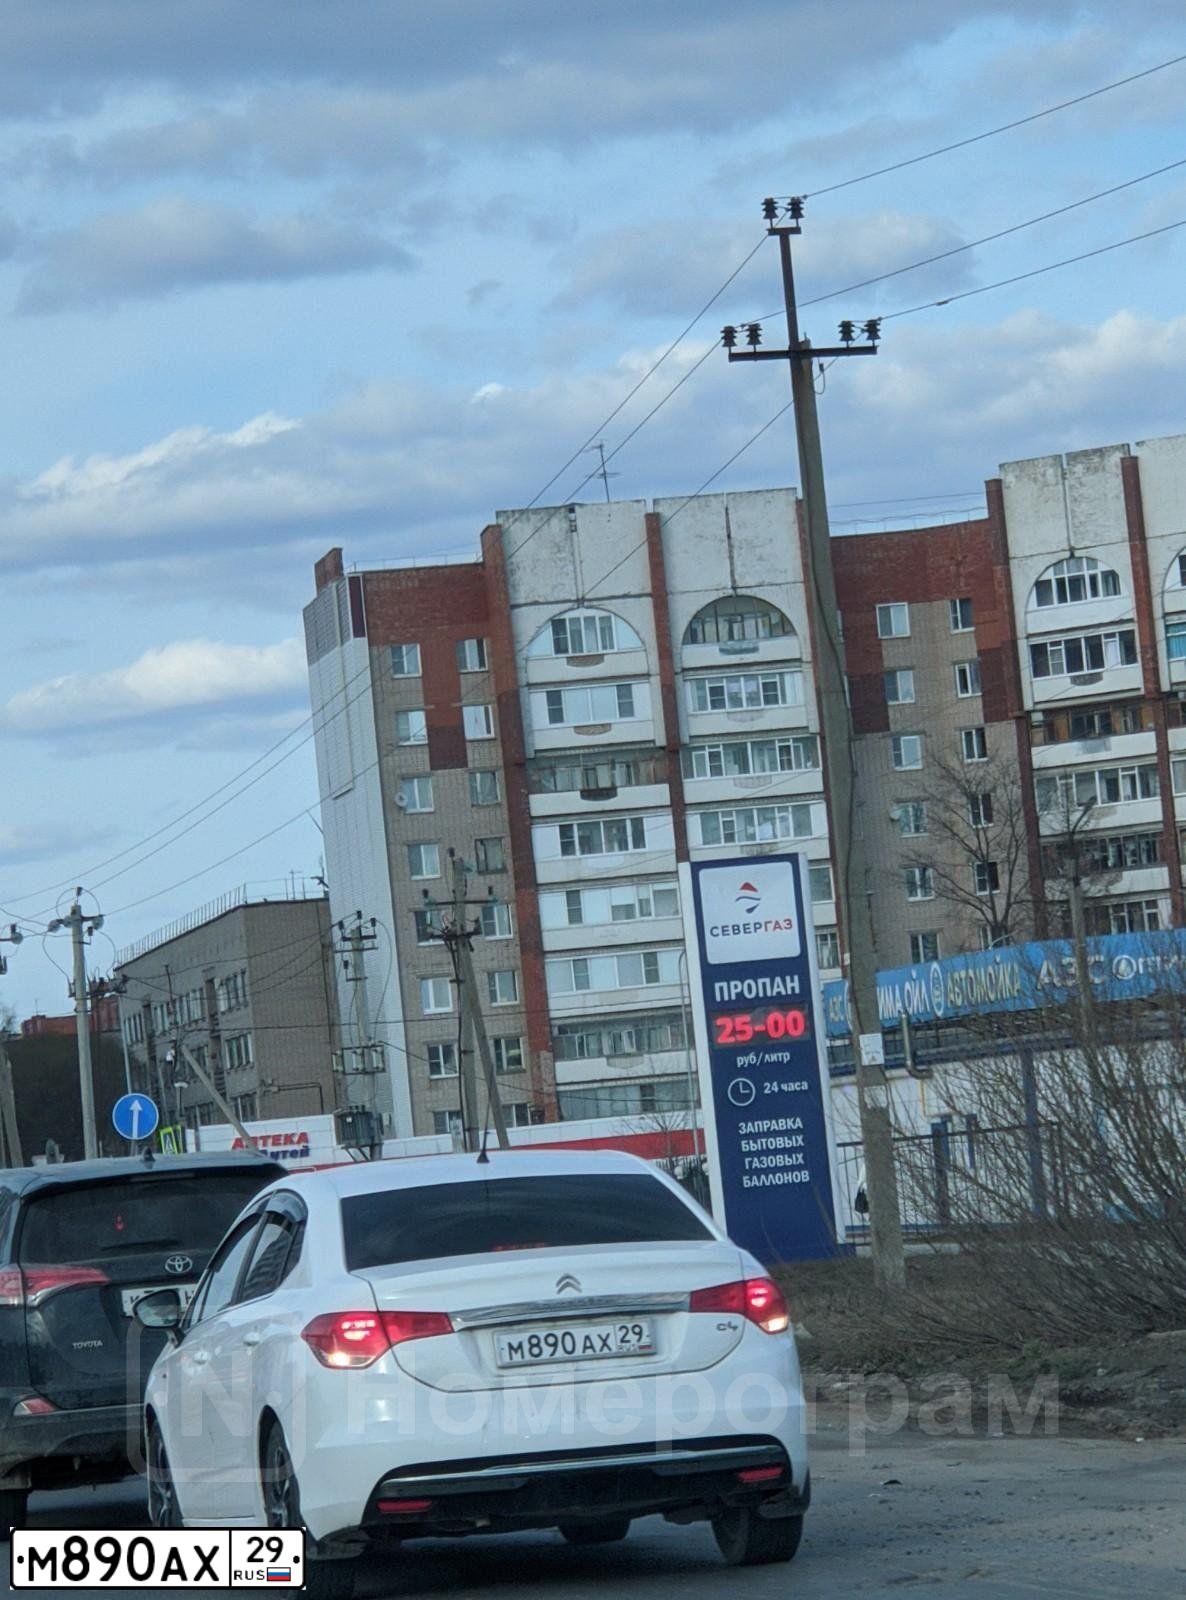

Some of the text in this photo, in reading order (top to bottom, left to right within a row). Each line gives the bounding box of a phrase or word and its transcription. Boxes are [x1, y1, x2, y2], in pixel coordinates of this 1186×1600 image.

[710, 918, 793, 937] СЕВЕРГАЗ
[714, 974, 800, 1002] ПРОПАН
[715, 1010, 806, 1045] 25-00
[736, 1052, 790, 1067] руб/литр
[763, 1080, 808, 1095] 24 часа
[738, 1117, 803, 1135] ЗАПРАВКА
[741, 1135, 805, 1152] БЫТОВЫХ
[744, 1153, 805, 1170] ГАЗОВЫХ
[742, 1170, 810, 1188] БАЛЛОНОВ
[72, 1340, 103, 1350] TOYOTA
[507, 1323, 643, 1361] М890АХ 29
